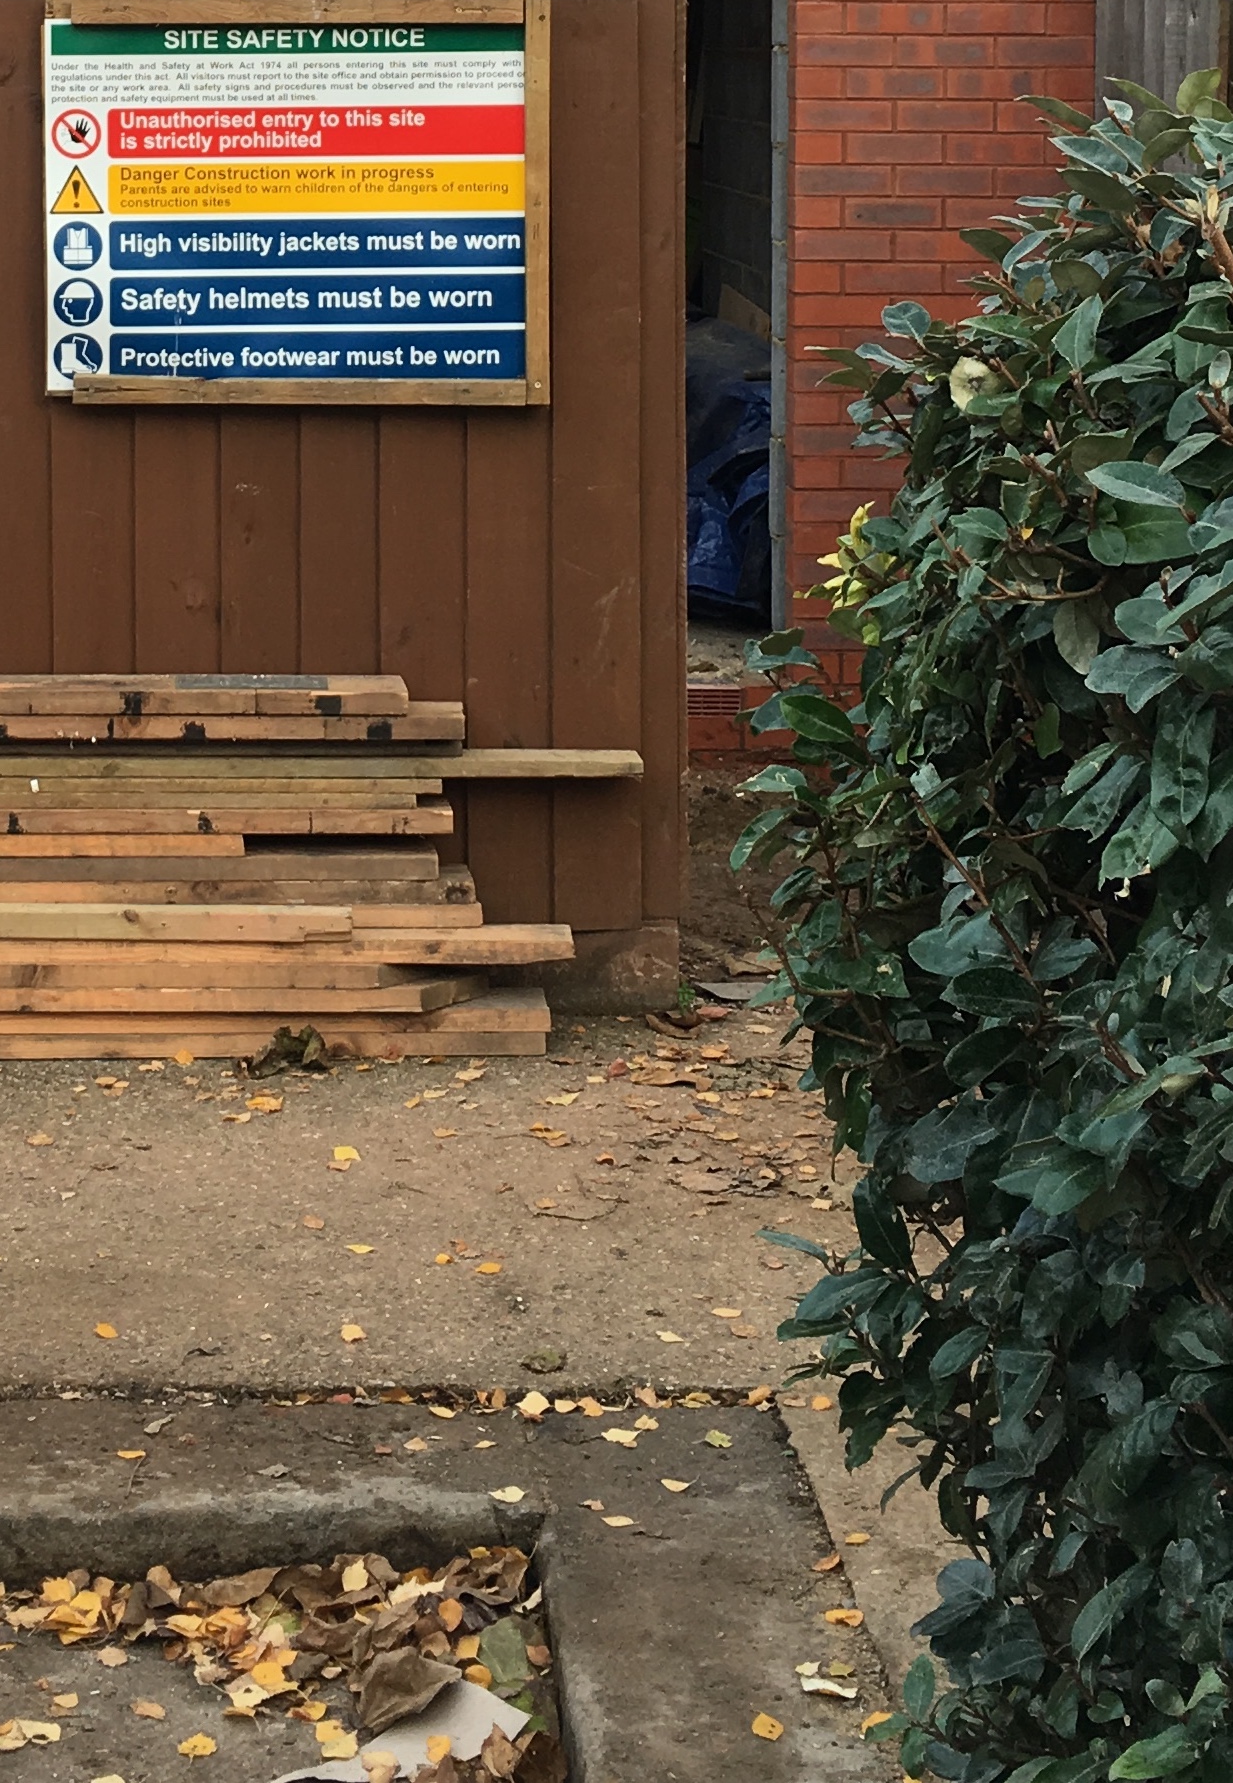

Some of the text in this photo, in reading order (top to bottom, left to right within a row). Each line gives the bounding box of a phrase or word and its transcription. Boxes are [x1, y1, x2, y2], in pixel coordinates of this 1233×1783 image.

[163, 28, 425, 49] SITE SAFETY NOTICE
[50, 62, 78, 70] Under
[84, 62, 98, 70] the
[104, 62, 133, 70] Health
[138, 62, 156, 70] and
[161, 61, 190, 71] Safety
[209, 61, 233, 69] Work
[238, 61, 254, 69] Act
[260, 60, 281, 69] 1974
[286, 61, 297, 69] all
[302, 62, 340, 70] persons
[345, 61, 384, 70] entering
[389, 60, 406, 68] this
[411, 60, 428, 68] site
[462, 59, 496, 69] comply
[502, 59, 521, 67] with
[50, 73, 102, 82] regulations
[175, 72, 188, 80] All
[190, 72, 225, 80] visitors
[227, 72, 250, 80] must
[252, 72, 281, 81] report
[283, 72, 293, 80] to
[294, 71, 309, 79] the
[312, 71, 329, 79] site
[331, 71, 357, 79] office
[359, 71, 377, 79] and
[379, 71, 408, 79] obtain
[410, 71, 462, 80] permission
[464, 70, 473, 78] to
[476, 70, 514, 79] proceed
[50, 84, 65, 92] the
[69, 84, 86, 92] site
[102, 85, 119, 93] any
[177, 82, 190, 90] All
[193, 82, 221, 92] safety
[224, 84, 250, 92] signs
[253, 82, 271, 91] and
[274, 82, 326, 92] procedures
[330, 82, 353, 90] must
[356, 82, 368, 90] be
[371, 81, 414, 89] observed
[417, 81, 435, 89] and
[438, 81, 453, 89] the
[51, 95, 98, 104] protection
[101, 94, 118, 102] and
[120, 93, 148, 103] safety
[150, 93, 199, 103] equipment
[227, 93, 238, 101] be
[240, 93, 264, 101] used
[265, 93, 275, 101] at
[277, 93, 288, 101] all
[120, 109, 425, 131] Unauthorised entry to this site
[120, 130, 321, 153] is strictly prohibited
[120, 165, 434, 184] Danger Construction work in progress
[120, 182, 508, 195] Parents are advised to warn children of the dangers of entering
[120, 196, 231, 207] construction sites
[119, 230, 520, 258] High visibility jackets must be worn
[121, 285, 492, 315] Safety helmets must be worn
[120, 345, 500, 367] Protective footwear must be worn
